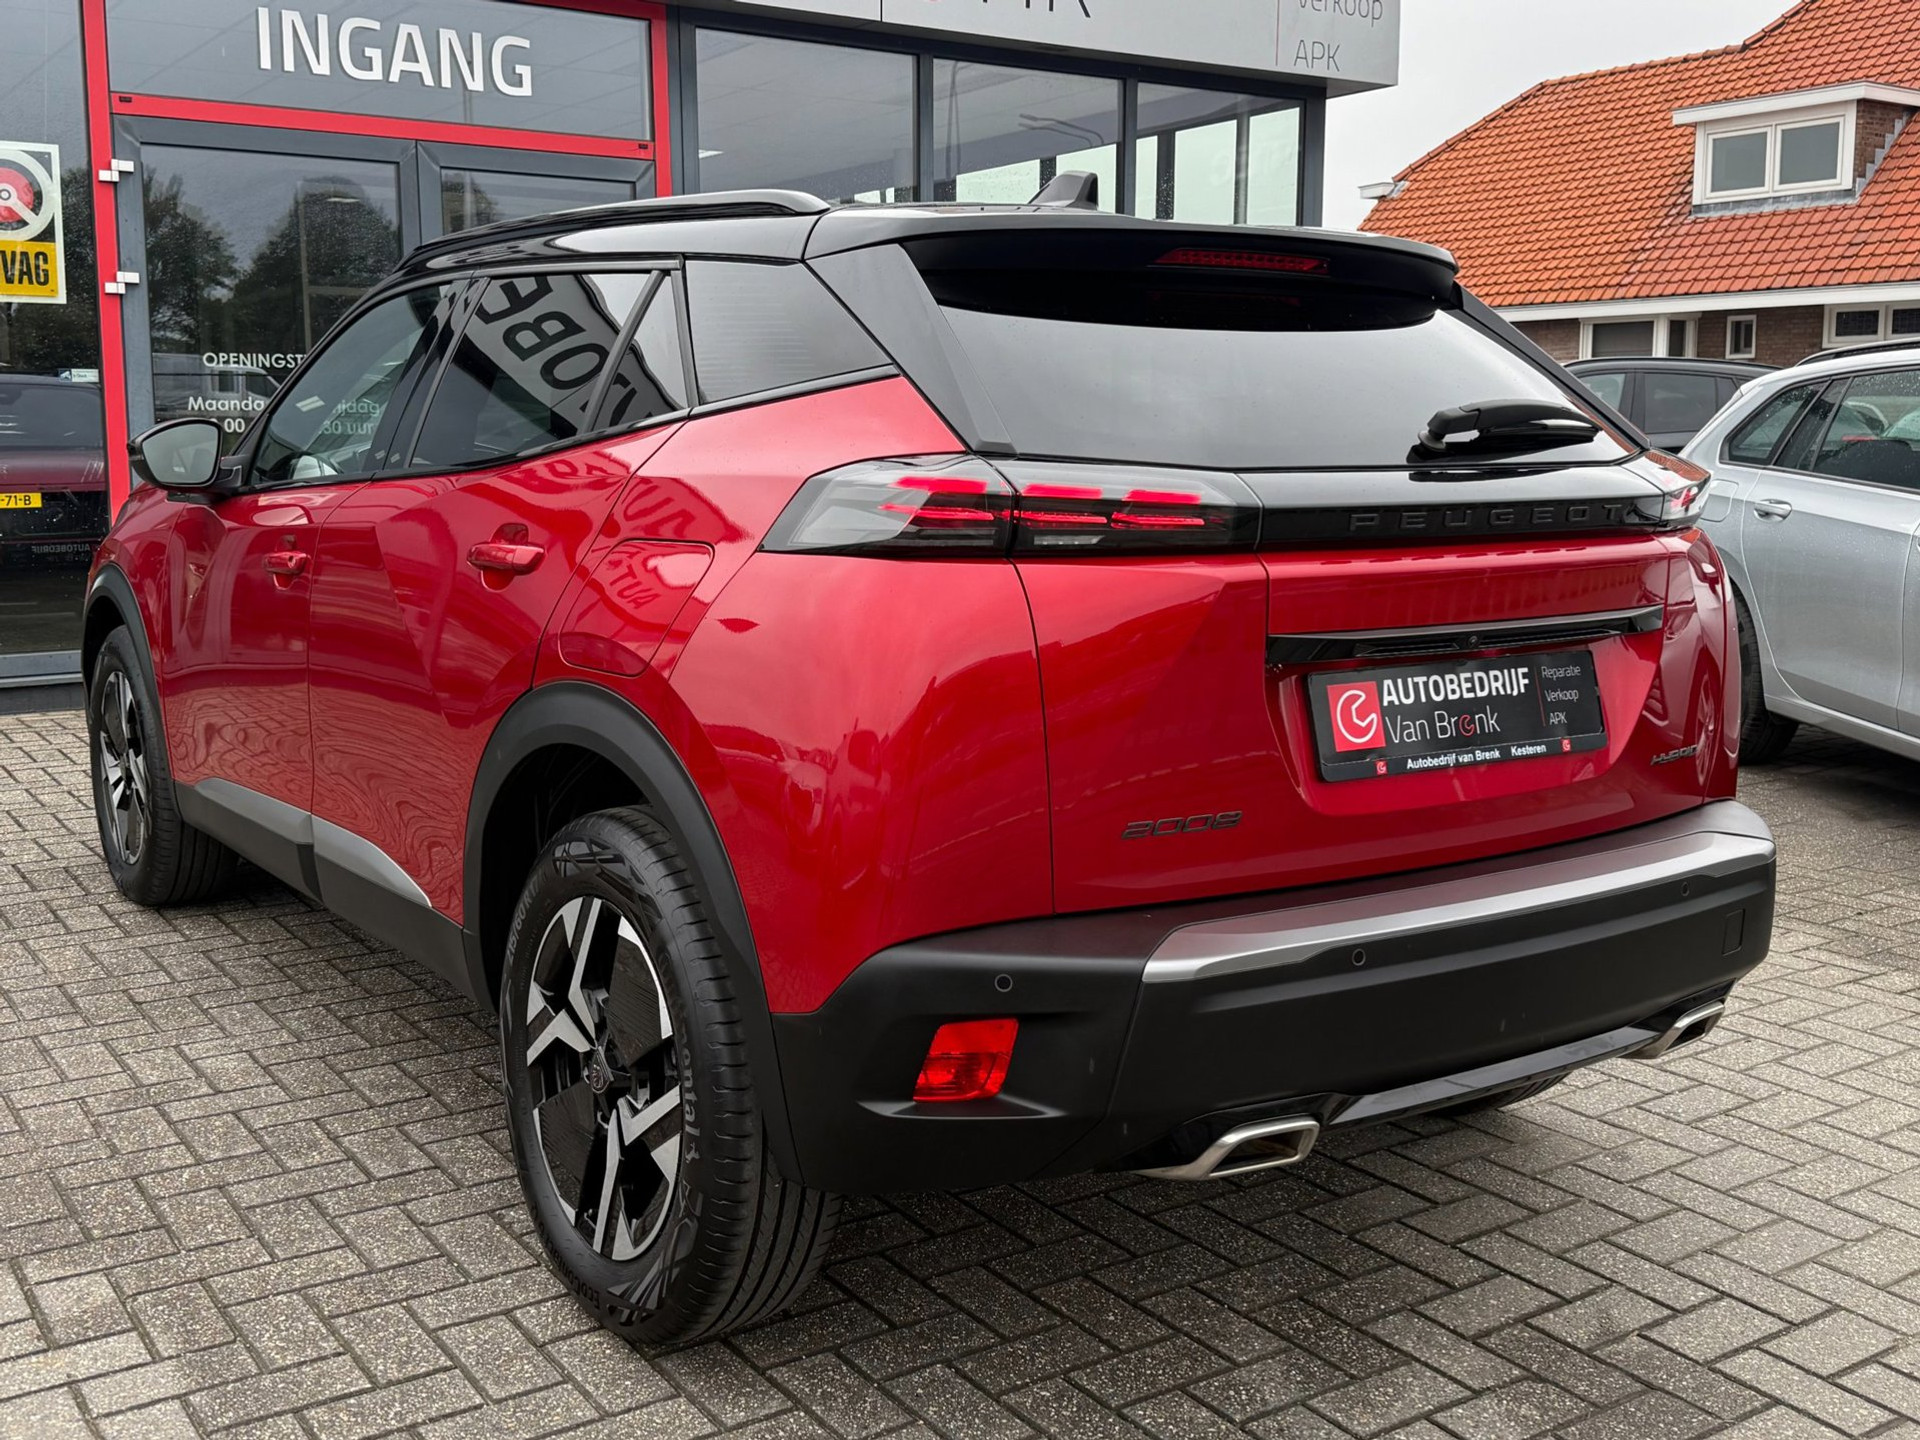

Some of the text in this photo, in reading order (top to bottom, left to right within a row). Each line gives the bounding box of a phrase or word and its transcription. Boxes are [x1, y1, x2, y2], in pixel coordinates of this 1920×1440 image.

[1300, 0, 1383, 28] eroop
[257, 7, 533, 97] INGANG
[1293, 39, 1340, 72] APK
[203, 352, 307, 368] OPENINGST
[1350, 504, 1622, 531] PEUGEOT
[1541, 665, 1581, 680] Reparatie
[1383, 667, 1529, 706] AUTOBEDRIJF
[1545, 689, 1579, 703] Verkoop
[1385, 715, 1430, 744] Van
[1549, 712, 1568, 726] APK
[1406, 744, 1546, 770] Autobedrijf van Brenk Kesteren
[1121, 810, 1243, 840] 2008
